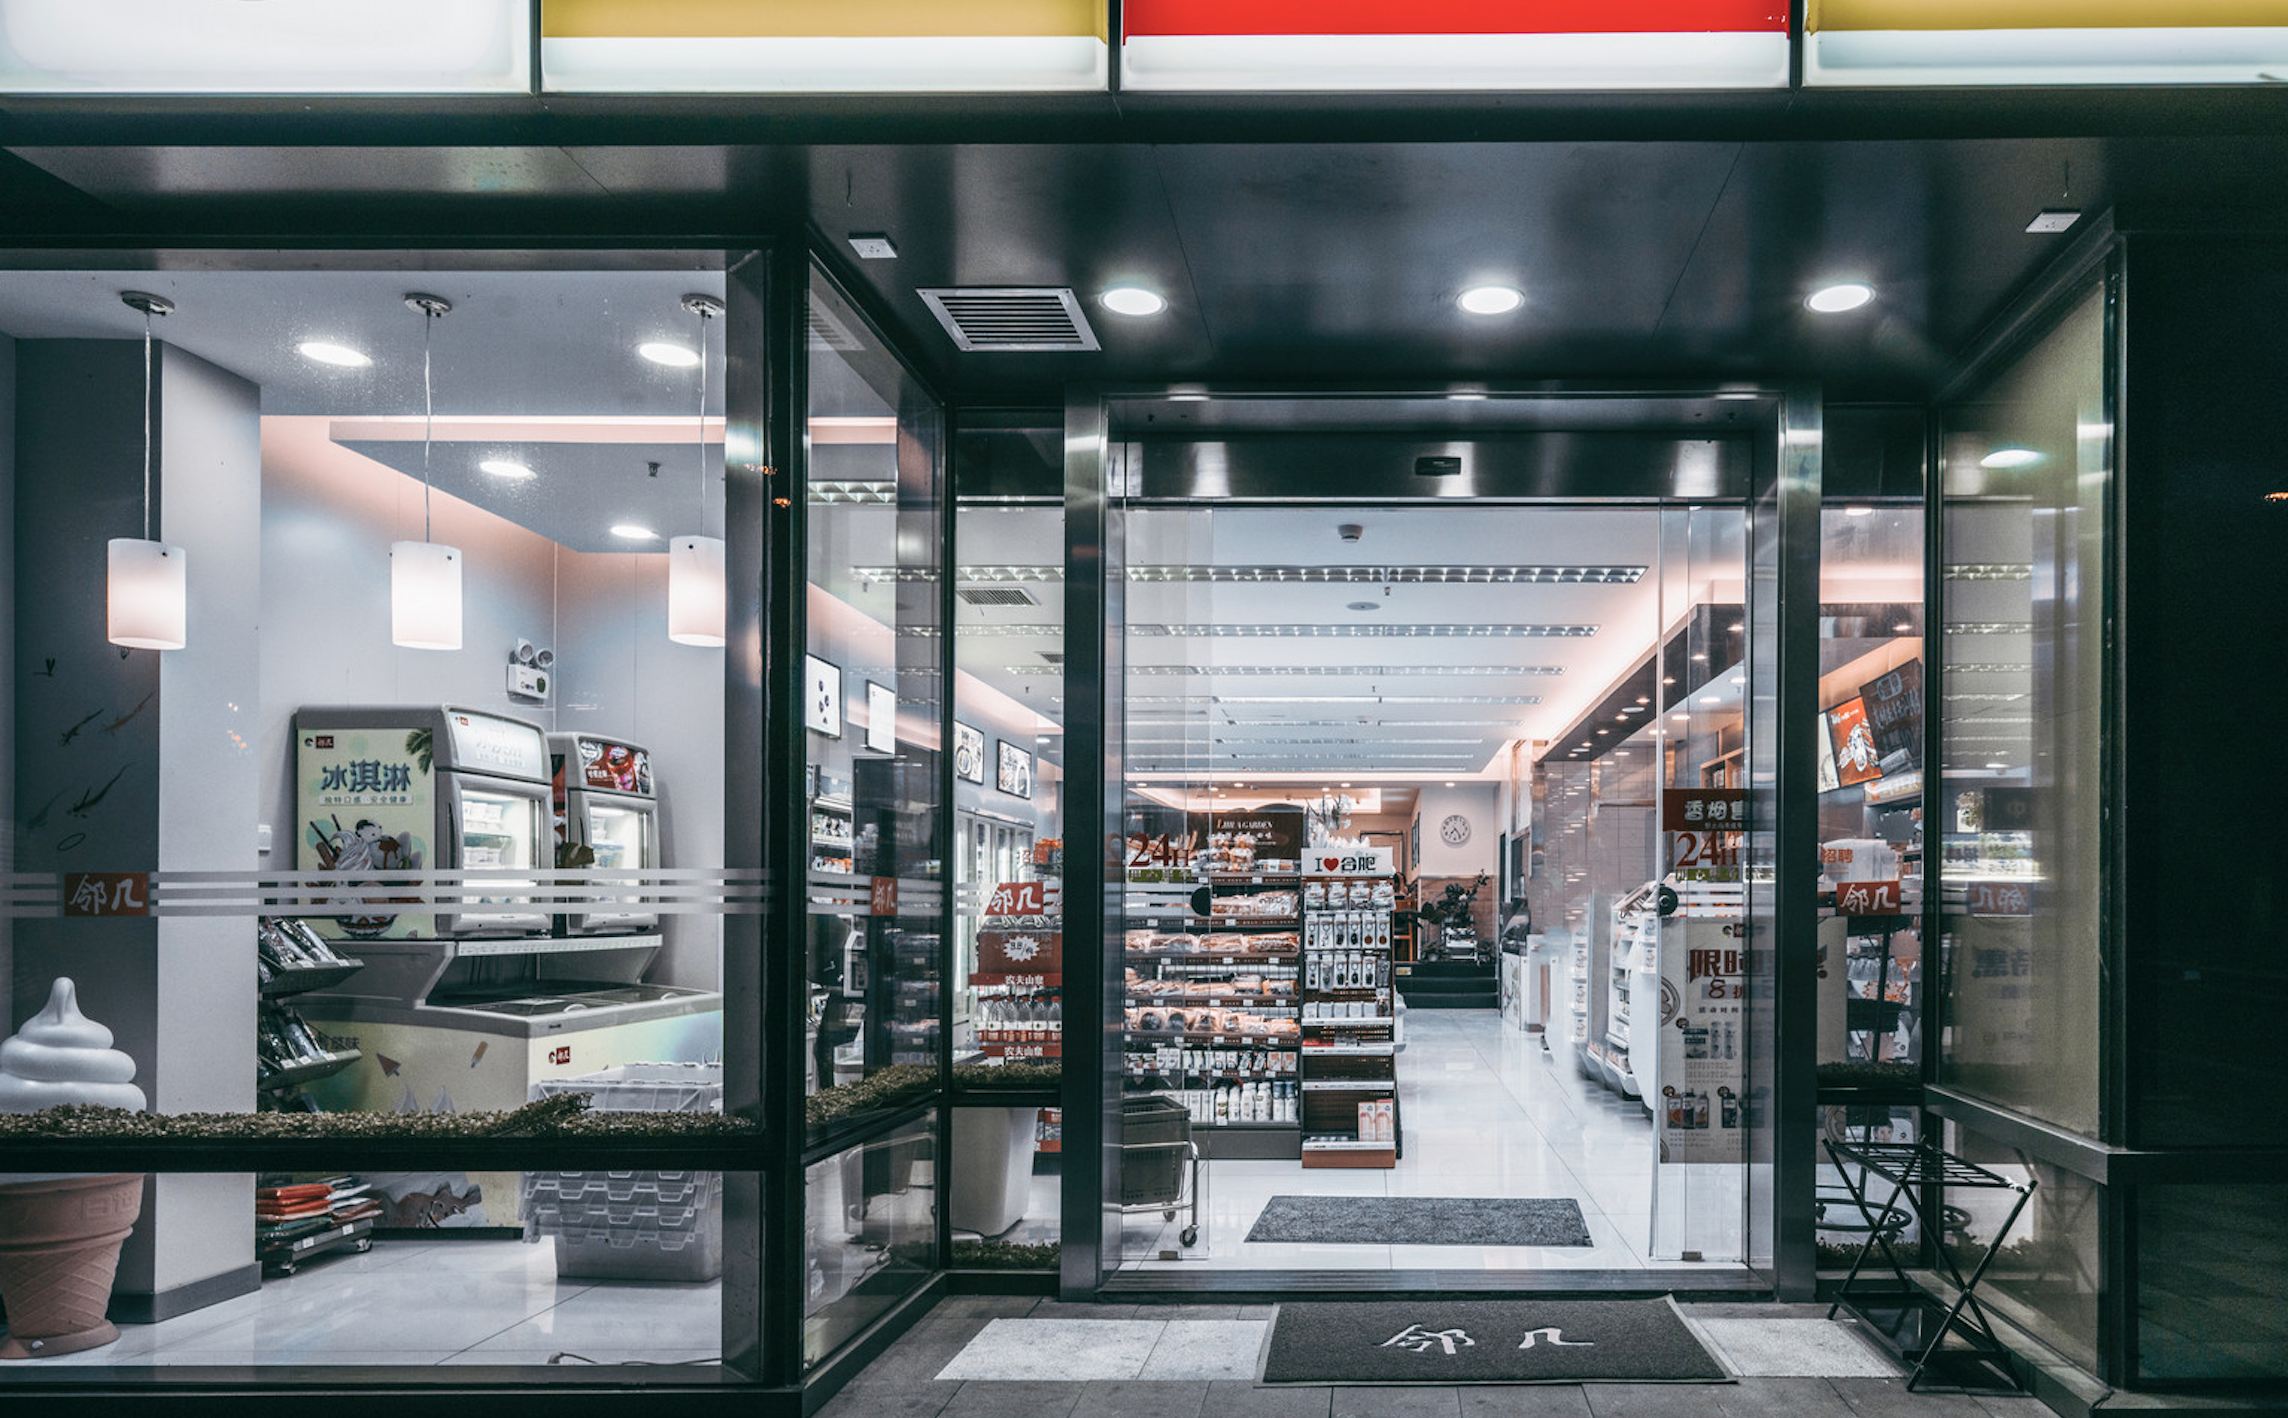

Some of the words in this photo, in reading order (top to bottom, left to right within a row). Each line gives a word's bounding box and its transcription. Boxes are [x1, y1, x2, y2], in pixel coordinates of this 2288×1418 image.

[321, 760, 411, 793] 冰淇淋
[1128, 833, 1189, 867] 24H
[1315, 858, 1322, 872] I
[1341, 857, 1376, 871] 合肥
[1822, 849, 1853, 864] 招聘
[69, 874, 143, 914] 邻几
[1840, 883, 1897, 914] 邻几
[1005, 975, 1044, 985] 农夫山泉
[1004, 1046, 1044, 1056] 农夫山泉
[1375, 1324, 1594, 1354] 邻几
